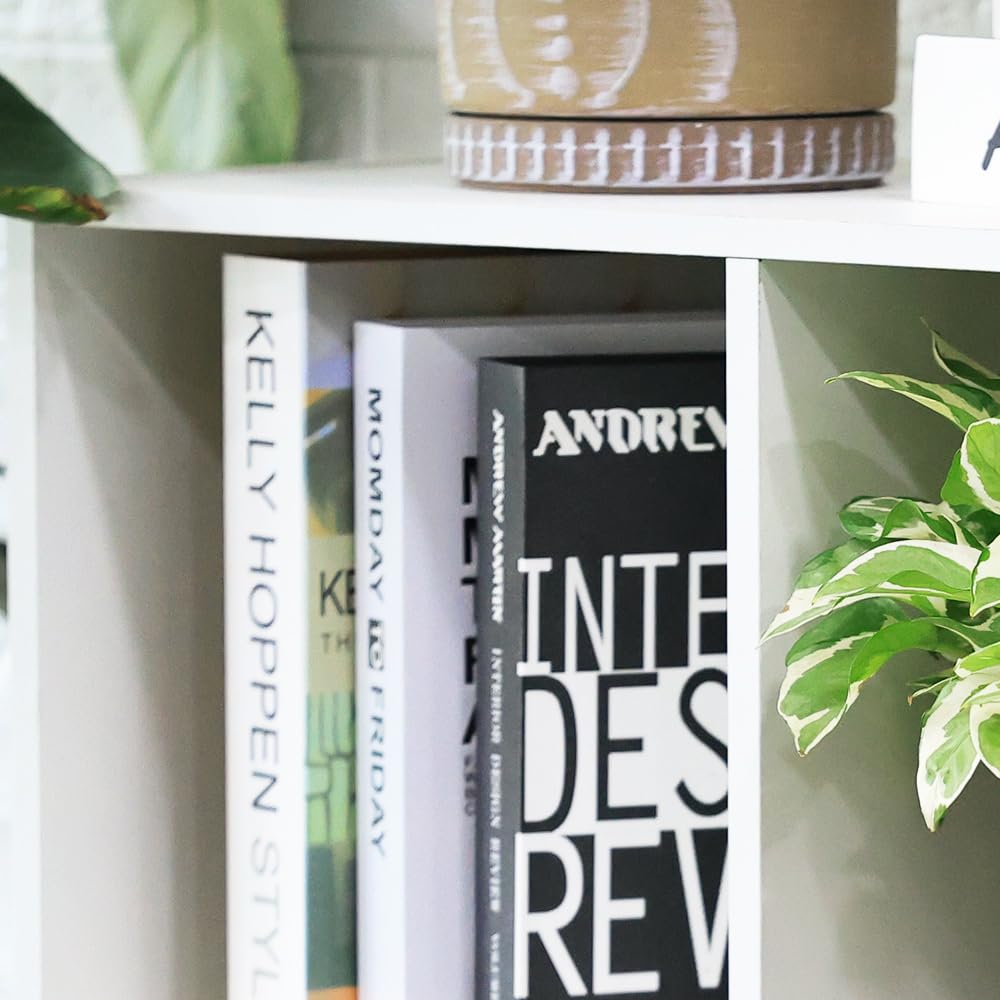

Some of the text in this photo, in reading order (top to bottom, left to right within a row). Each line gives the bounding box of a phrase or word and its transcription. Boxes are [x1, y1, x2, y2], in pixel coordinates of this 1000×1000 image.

[244, 310, 278, 512] KELLY
[247, 534, 280, 813] HOPPEN
[370, 685, 386, 857] FRIDAY
